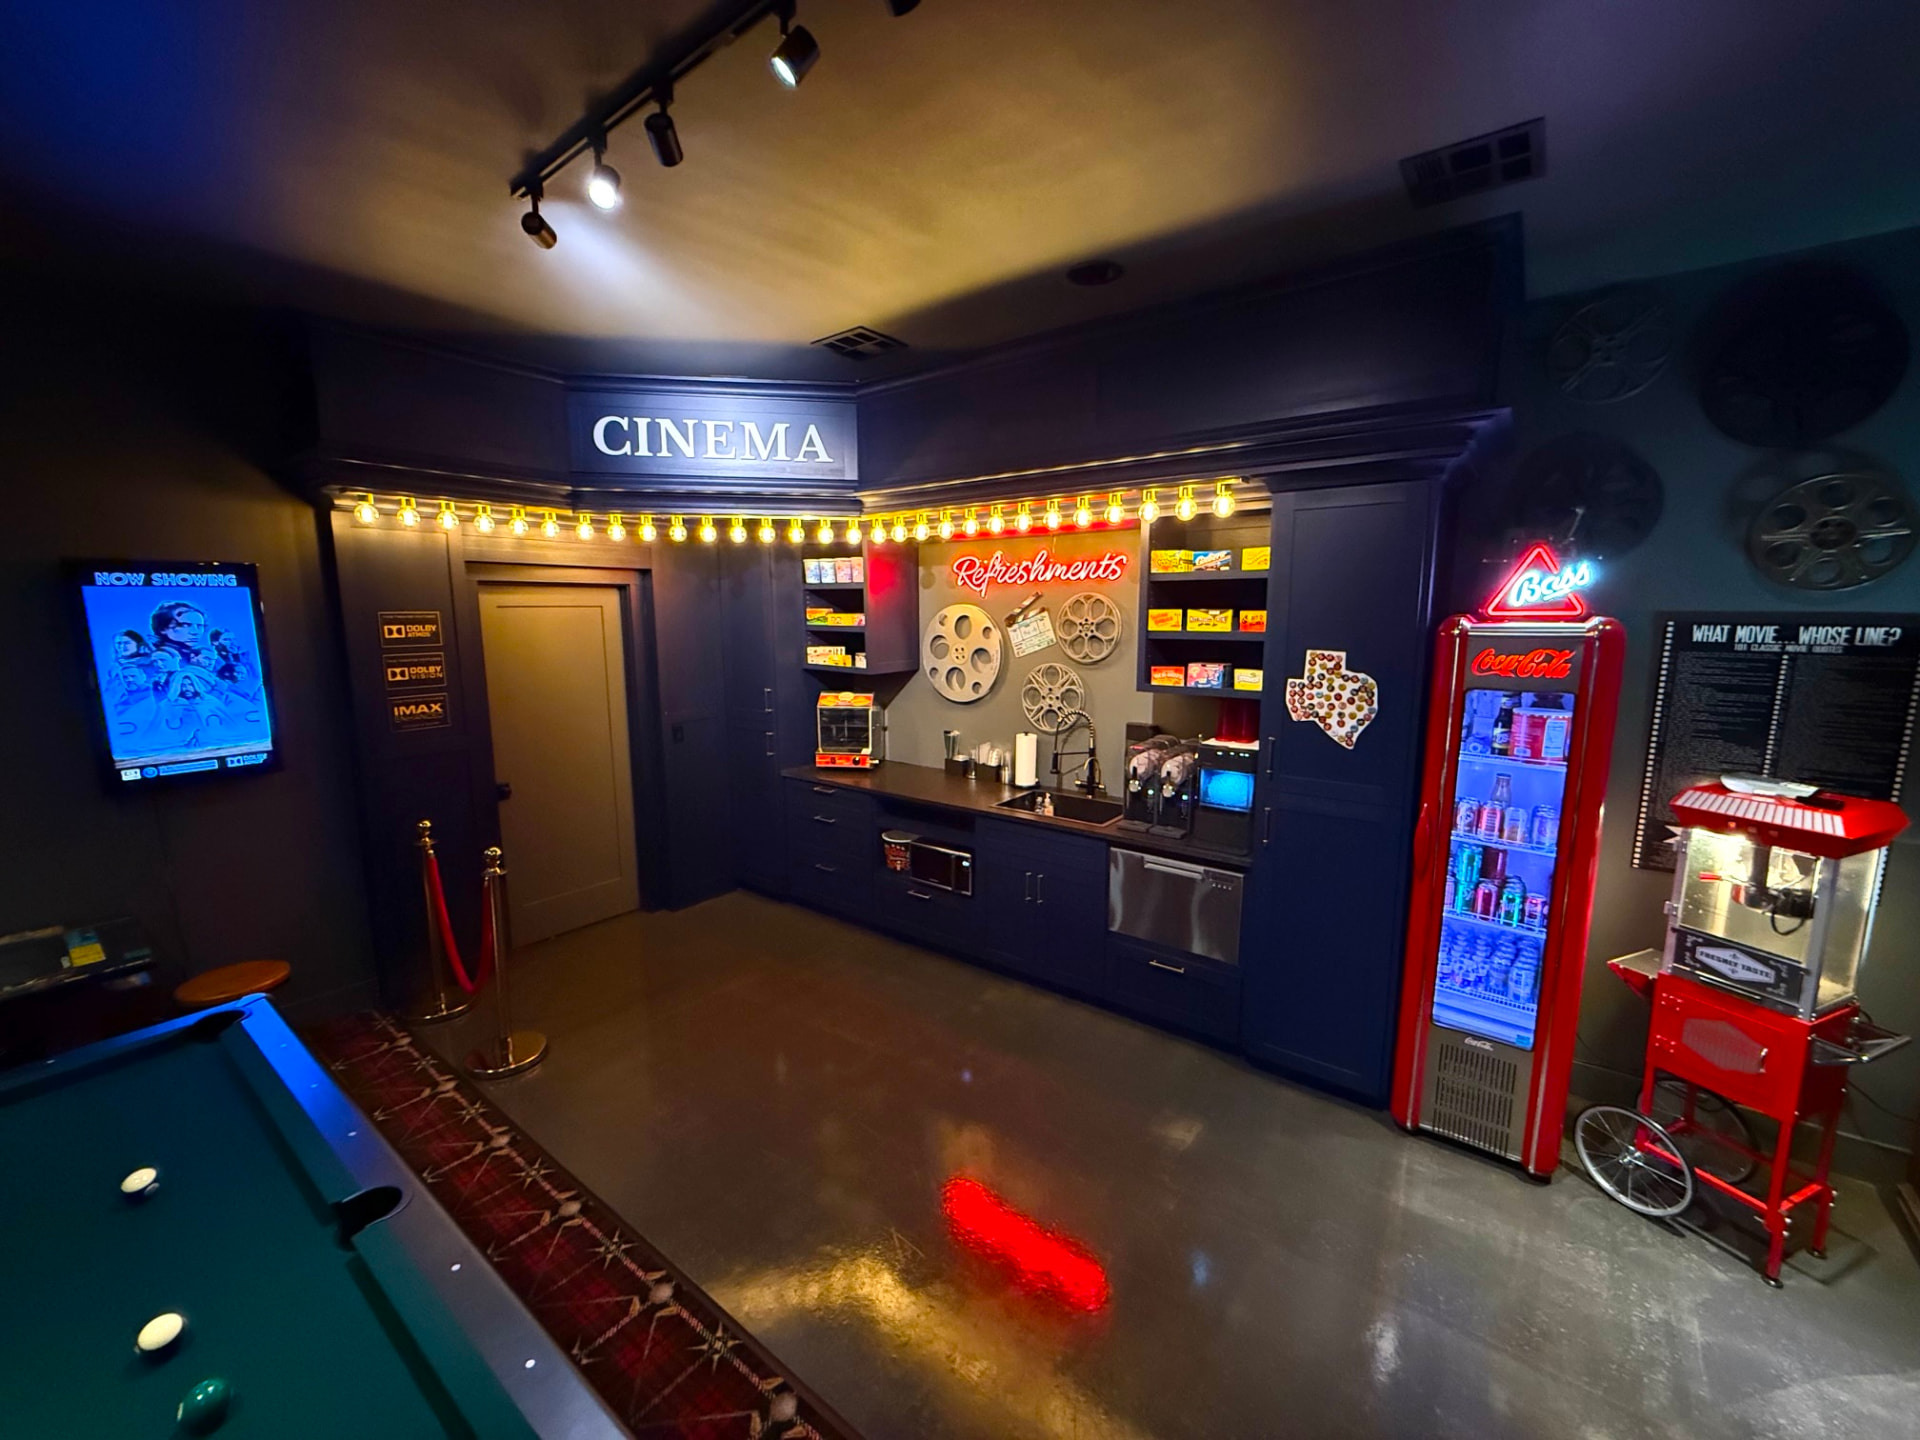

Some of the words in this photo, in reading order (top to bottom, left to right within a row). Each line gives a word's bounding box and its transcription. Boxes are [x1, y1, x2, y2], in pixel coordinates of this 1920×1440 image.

[593, 415, 835, 463] CINEMA
[94, 572, 145, 586] NOW
[151, 573, 238, 587] SHOWING
[953, 550, 1127, 598] Refreshments
[1510, 561, 1590, 606] Bass
[406, 624, 437, 632] DOLBY
[1692, 624, 1731, 643] WHAT
[1798, 625, 1851, 646] WHOSE
[1854, 626, 1902, 647] LINE?
[410, 666, 442, 674] DOLBY
[1471, 648, 1576, 679] Coca-Cola
[411, 672, 443, 680] VISION
[394, 703, 443, 717] IMAX
